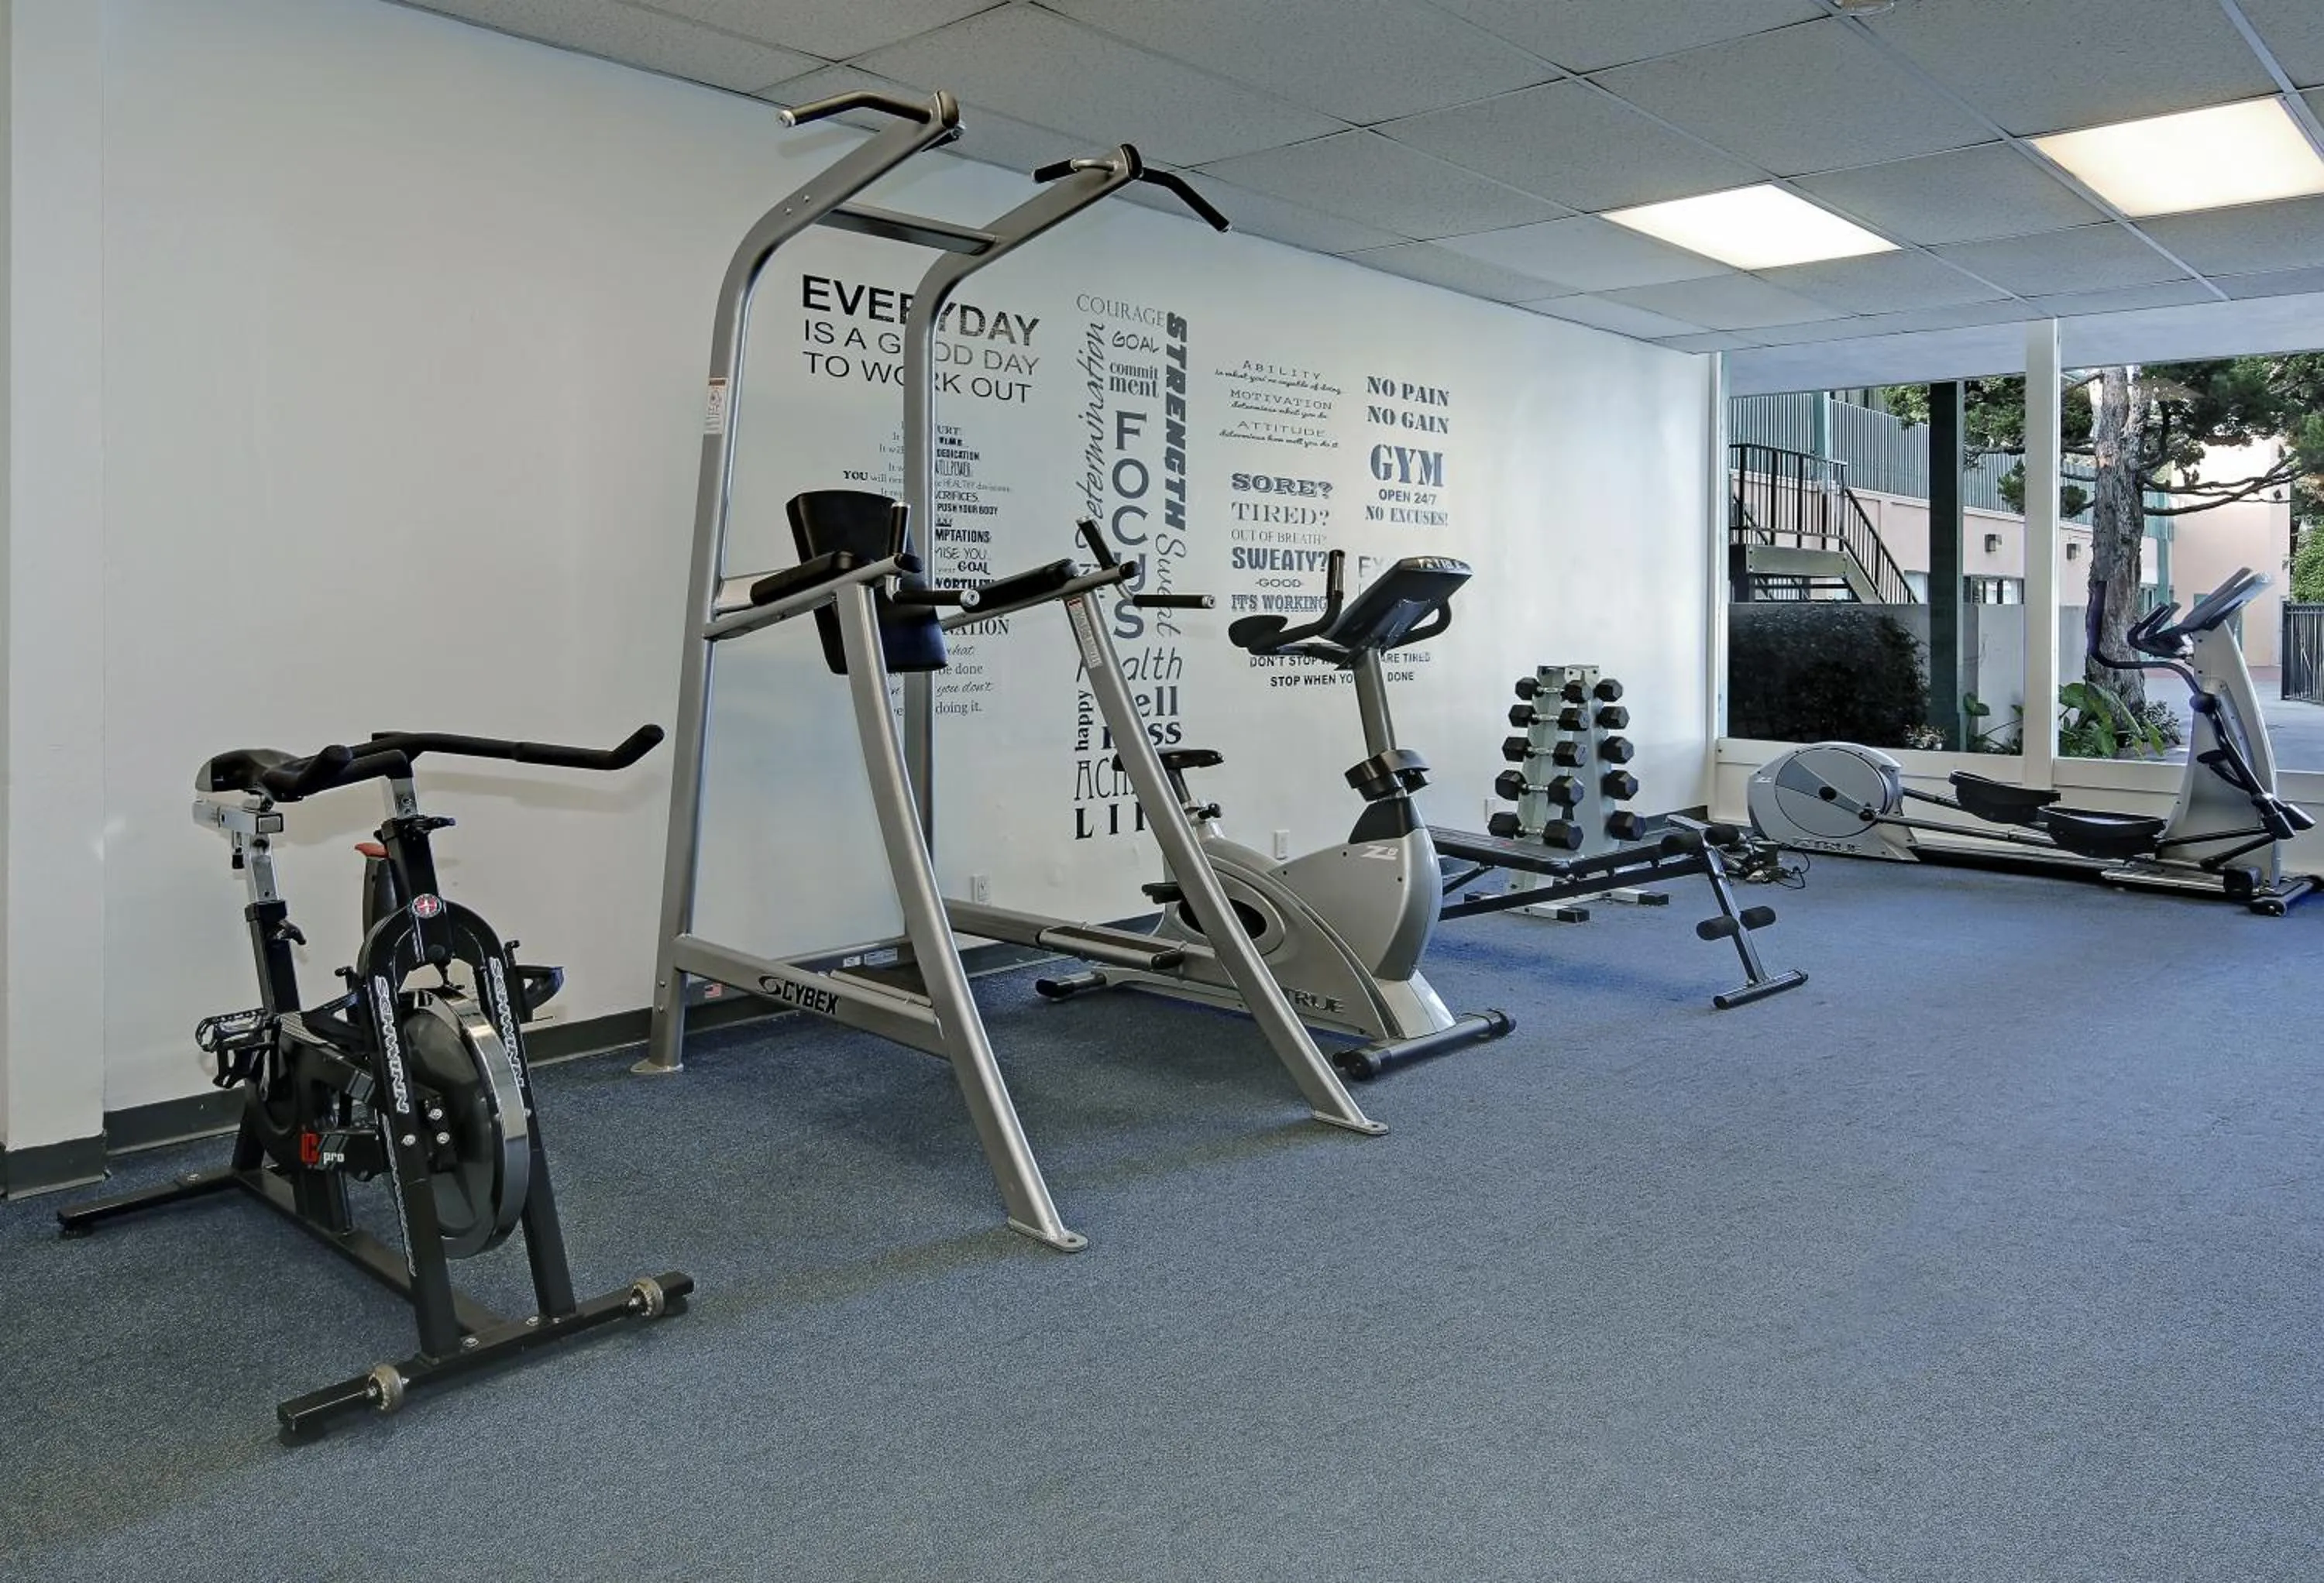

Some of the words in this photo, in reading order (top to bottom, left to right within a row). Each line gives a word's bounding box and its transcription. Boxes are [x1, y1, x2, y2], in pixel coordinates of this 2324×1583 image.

[1076, 294, 1166, 327] COURAGE
[804, 319, 834, 344] IS
[844, 328, 867, 349] A
[878, 332, 973, 366] GOD
[984, 349, 1040, 376] DAY
[1112, 330, 1160, 353] GOAL
[803, 351, 850, 378] TO
[861, 359, 961, 394] WK
[971, 377, 1033, 403] OUT
[1109, 362, 1158, 380] commit
[1243, 360, 1322, 380] ABILITY
[1109, 376, 1160, 398] ment
[1367, 376, 1396, 397] NO
[1401, 383, 1449, 407] PAIN
[1230, 389, 1332, 410] MOTIVATION
[1164, 311, 1188, 531] STRENGTH
[1237, 421, 1326, 438] ATTITUDE
[1367, 405, 1396, 426] NO
[1401, 411, 1449, 434] GAIN
[843, 469, 868, 481] YOU
[1370, 443, 1444, 487] GYM
[1231, 472, 1334, 500] SORE?
[1378, 489, 1411, 503] OPEN
[1231, 502, 1329, 527] TIRED?
[1365, 505, 1384, 521] NO
[1391, 507, 1449, 527] EXCUSES!
[1231, 528, 1255, 541] OUT
[1259, 530, 1274, 542] OF
[957, 560, 992, 575] GOAL
[1232, 546, 1329, 572] SWEATY?
[1231, 594, 1258, 612] IT'S
[1261, 595, 1328, 613] WORKING
[1250, 656, 1284, 668] DON'T
[1288, 656, 1316, 667] STOP
[1270, 675, 1301, 687] STOP
[1304, 675, 1336, 685] WHEN
[1339, 675, 1354, 685] YO
[1387, 671, 1414, 682] DONE
[936, 701, 968, 716] doing
[1135, 685, 1178, 717] ell
[1075, 688, 1094, 751] happy
[782, 980, 839, 1015] CYBEX
[374, 975, 410, 1114] SCHWINN
[323, 1152, 345, 1166] pro
